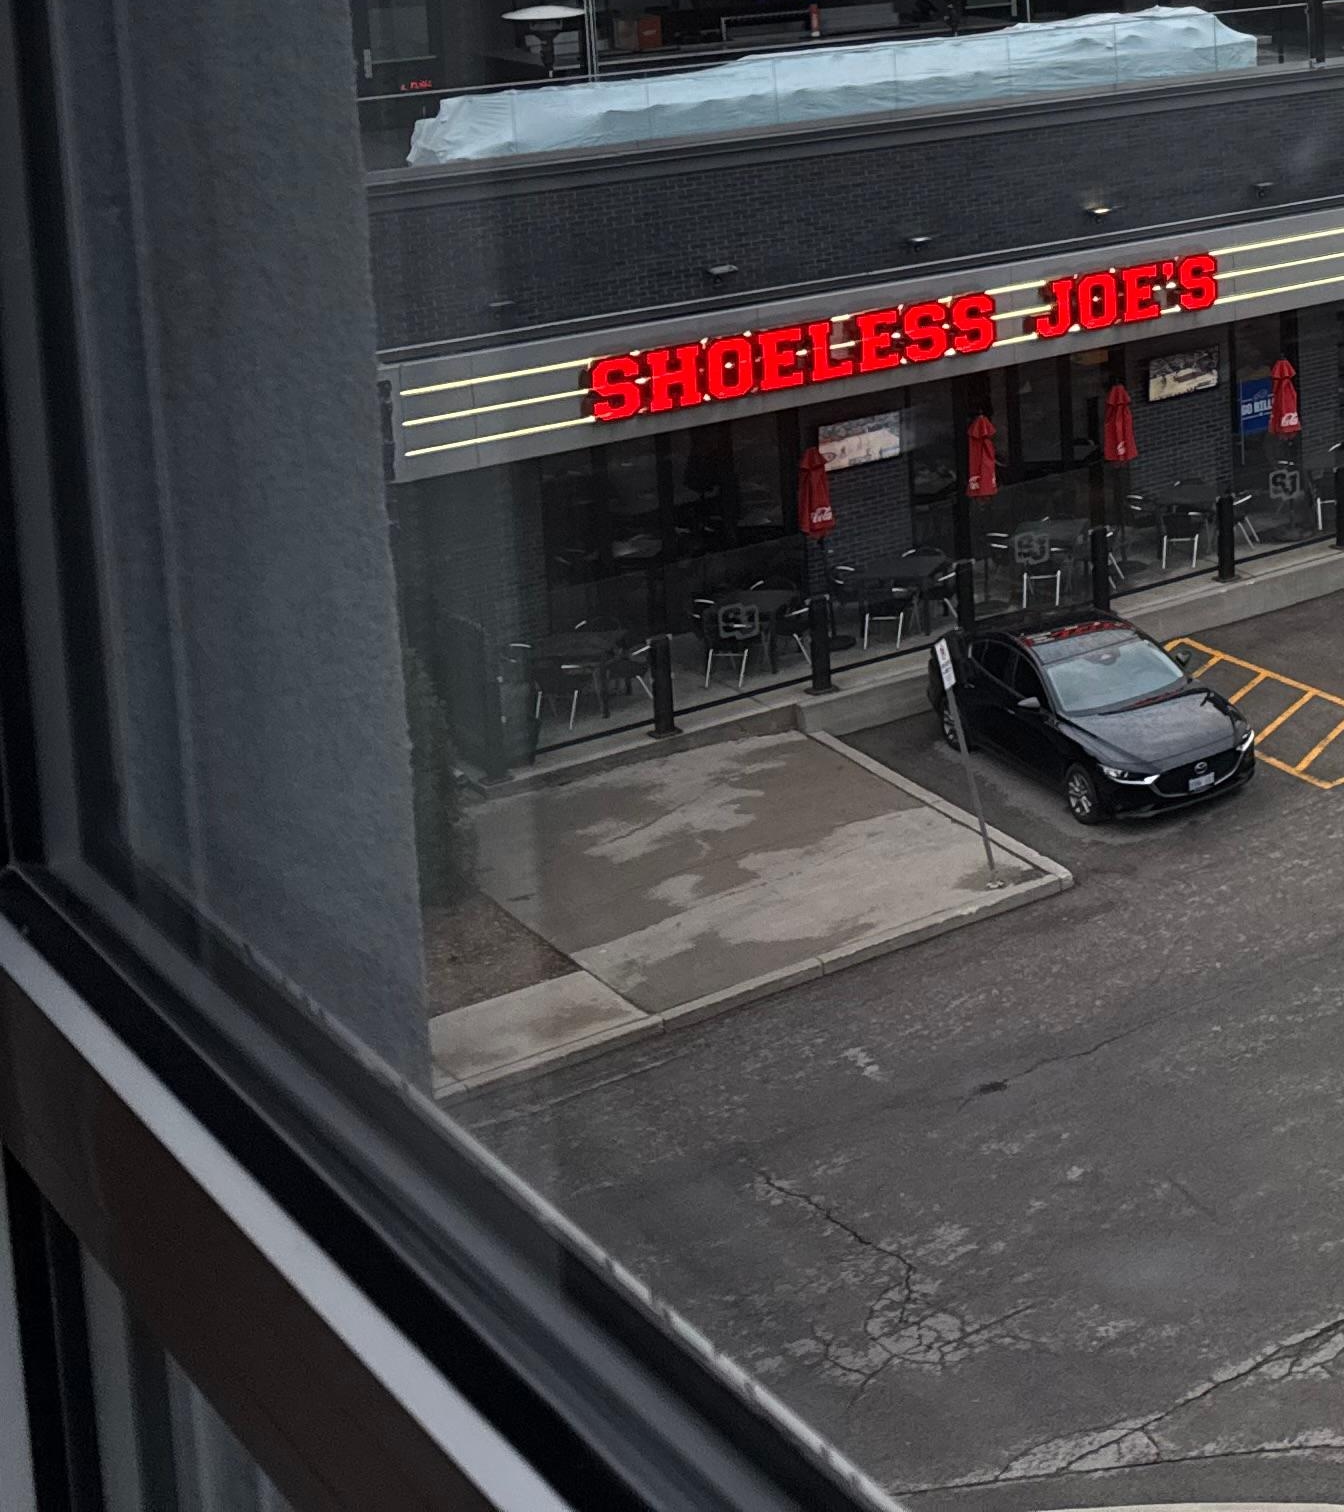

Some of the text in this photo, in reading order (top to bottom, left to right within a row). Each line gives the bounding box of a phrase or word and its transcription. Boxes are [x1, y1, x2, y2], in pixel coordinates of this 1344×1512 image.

[590, 253, 1218, 423] SHOELESS JOE'S
[1254, 397, 1274, 414] BILL
